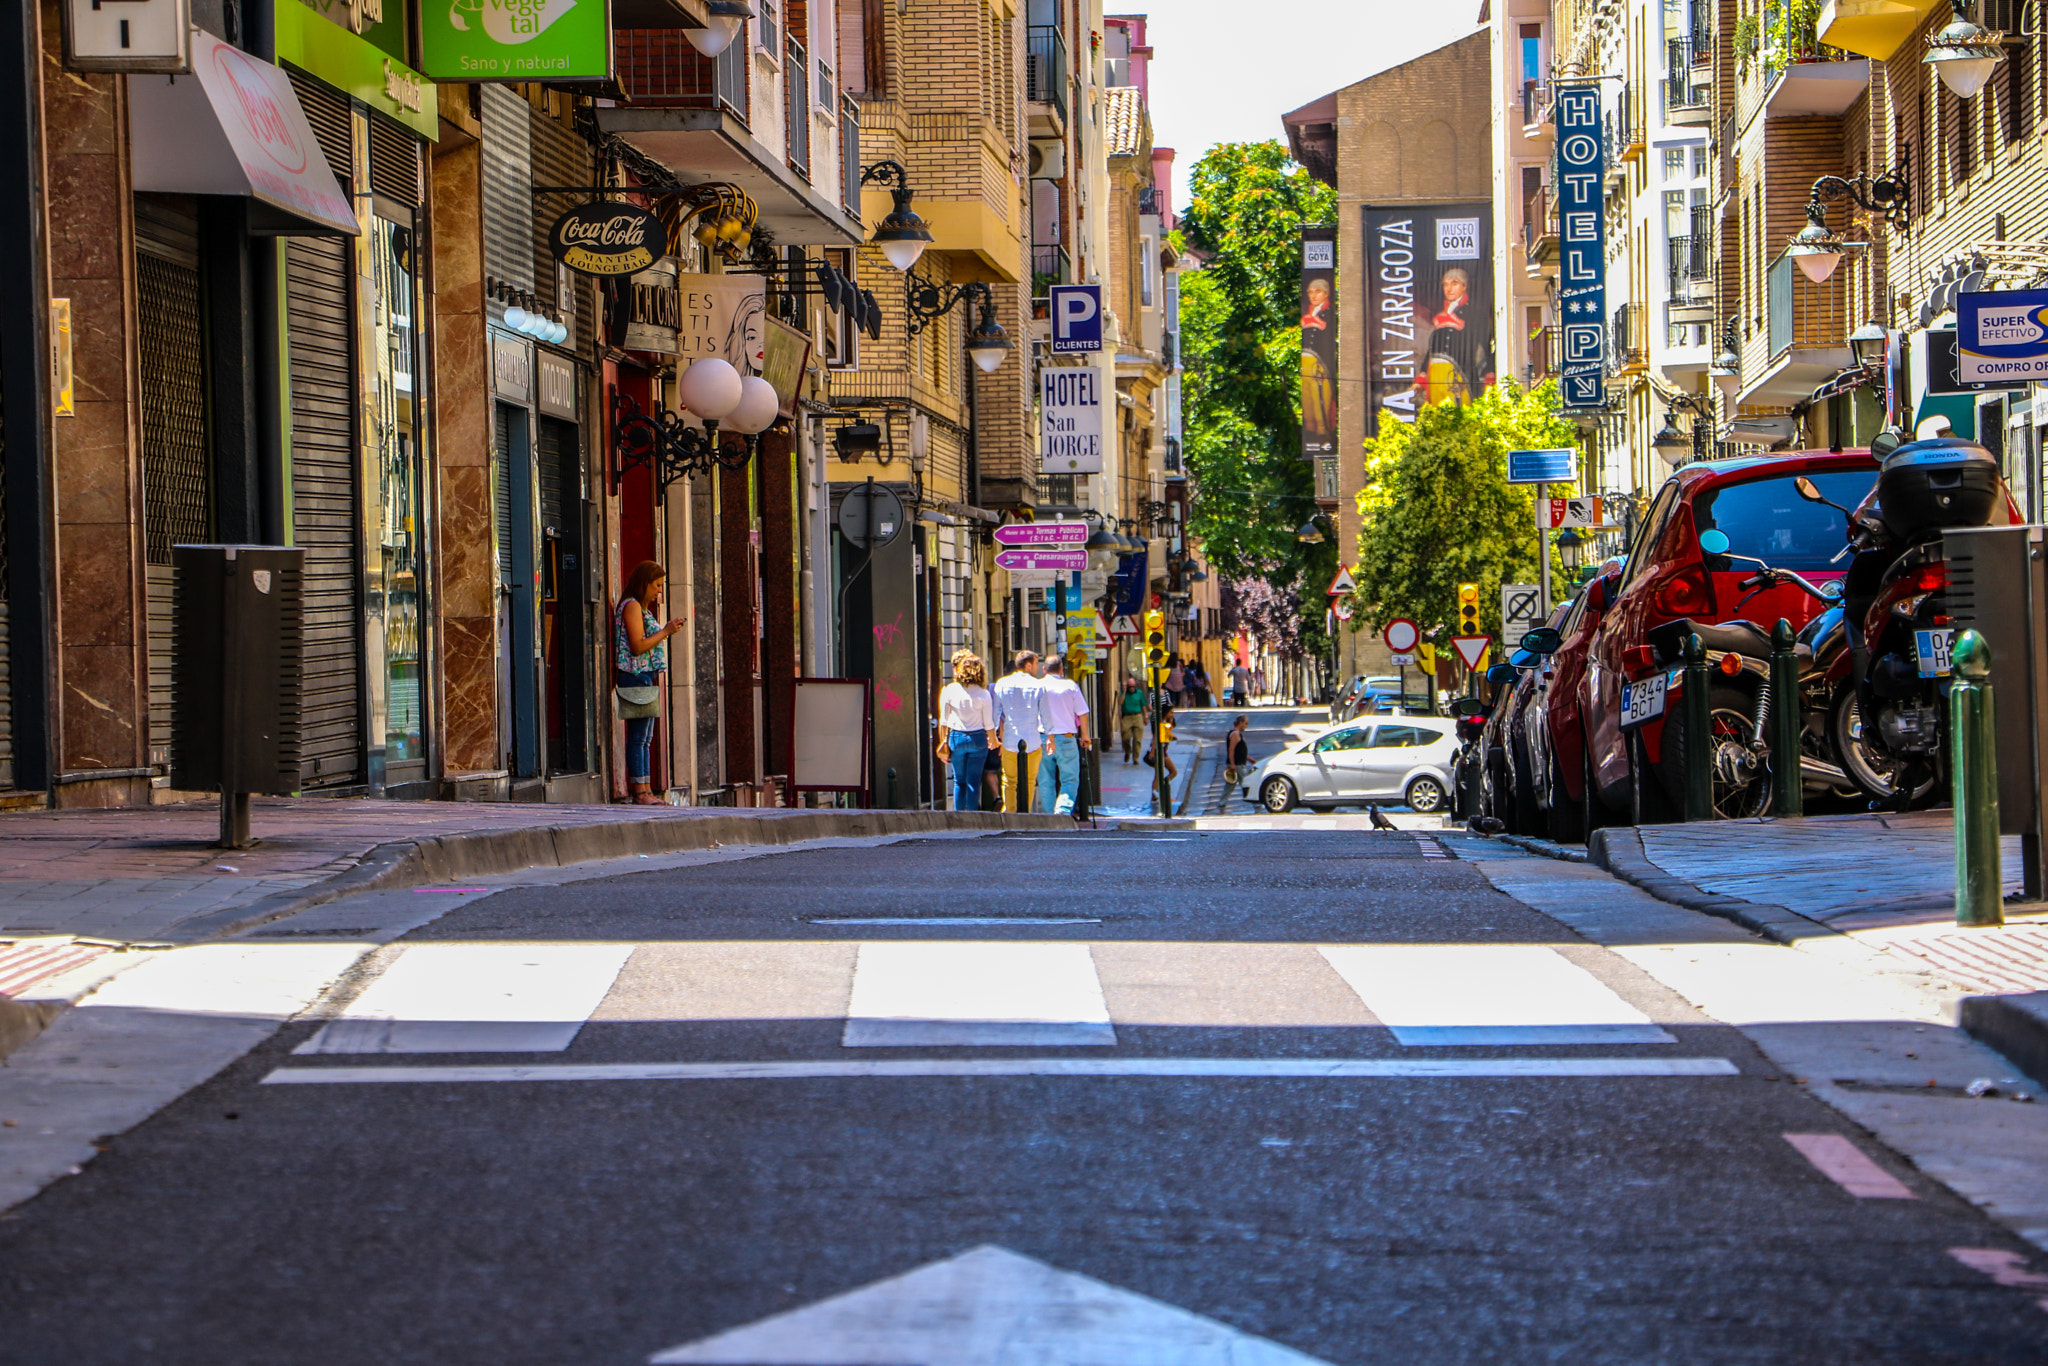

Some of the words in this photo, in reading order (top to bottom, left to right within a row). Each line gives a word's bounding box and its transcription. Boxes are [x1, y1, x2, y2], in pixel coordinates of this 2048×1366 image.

[510, 13, 540, 34] tal
[460, 55, 498, 70] Sano
[503, 58, 512, 74] y
[516, 55, 570, 70] natural
[1563, 97, 1600, 280] HOTEL
[1442, 224, 1474, 236] MUSEO
[1442, 236, 1474, 249] GOYA
[569, 257, 620, 273] LOUNGE
[623, 258, 647, 271] BAR
[584, 252, 637, 264] MANTIS
[1308, 253, 1330, 261] GOYA
[1380, 219, 1415, 341] ZARAGOZA
[688, 292, 714, 310] ES
[1057, 291, 1097, 339] P
[1982, 316, 2026, 328] SUPER
[1981, 327, 2037, 340] EFECTIVO
[1054, 340, 1100, 351] CLIENTES
[1570, 329, 1600, 358] P
[1382, 350, 1416, 379] EN
[1977, 362, 2031, 374] COMPRO
[1045, 372, 1098, 407] HOTEL
[1046, 410, 1075, 433] San
[1046, 434, 1100, 459] JORGE
[1924, 452, 1961, 460] HONDA
[1555, 512, 1560, 520] 1
[1036, 527, 1057, 535] Termas
[1059, 526, 1084, 534] Públicas
[1034, 552, 1084, 562] Caesaraugusta
[1632, 679, 1663, 702] 7344
[1631, 697, 1655, 720] BCT
